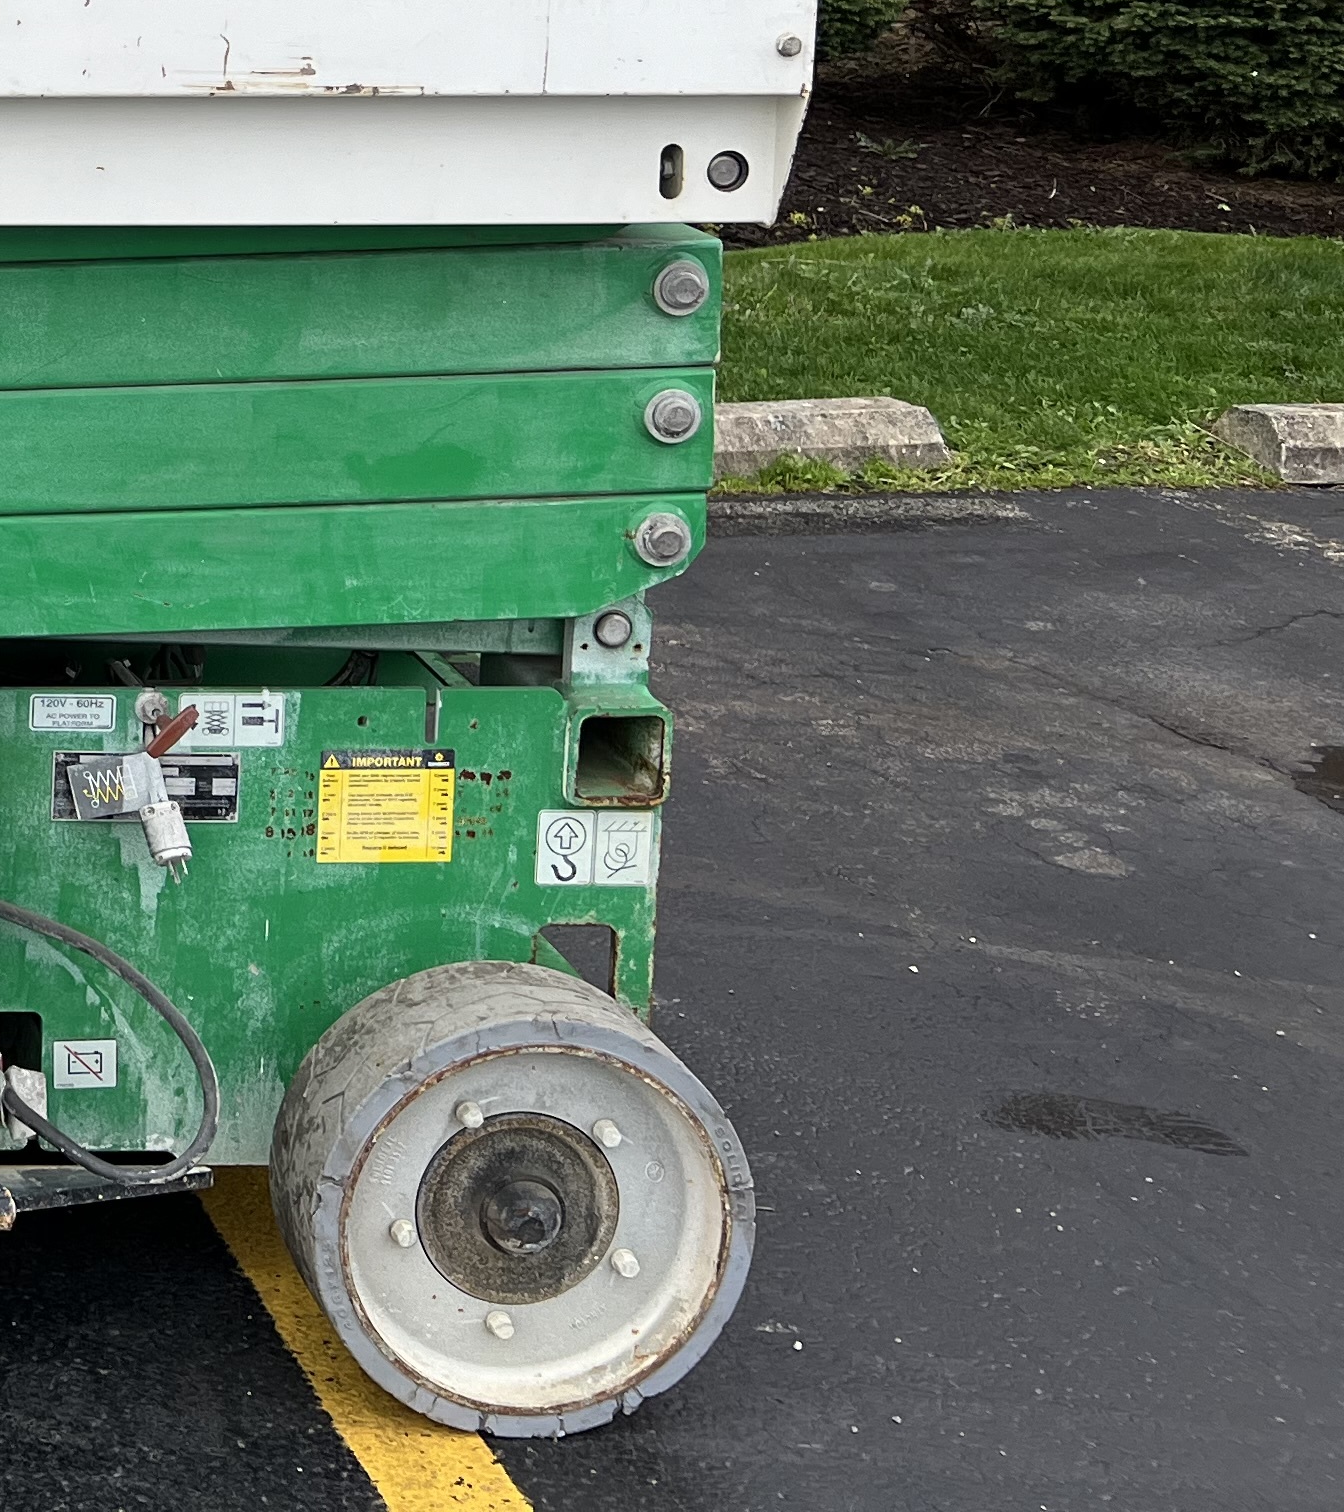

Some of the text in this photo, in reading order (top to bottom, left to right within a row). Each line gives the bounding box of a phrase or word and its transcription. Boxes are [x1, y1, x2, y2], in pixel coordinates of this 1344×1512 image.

[40, 698, 67, 708] 120V
[76, 699, 104, 708] 60Hz
[352, 756, 423, 767] IMPORTANT
